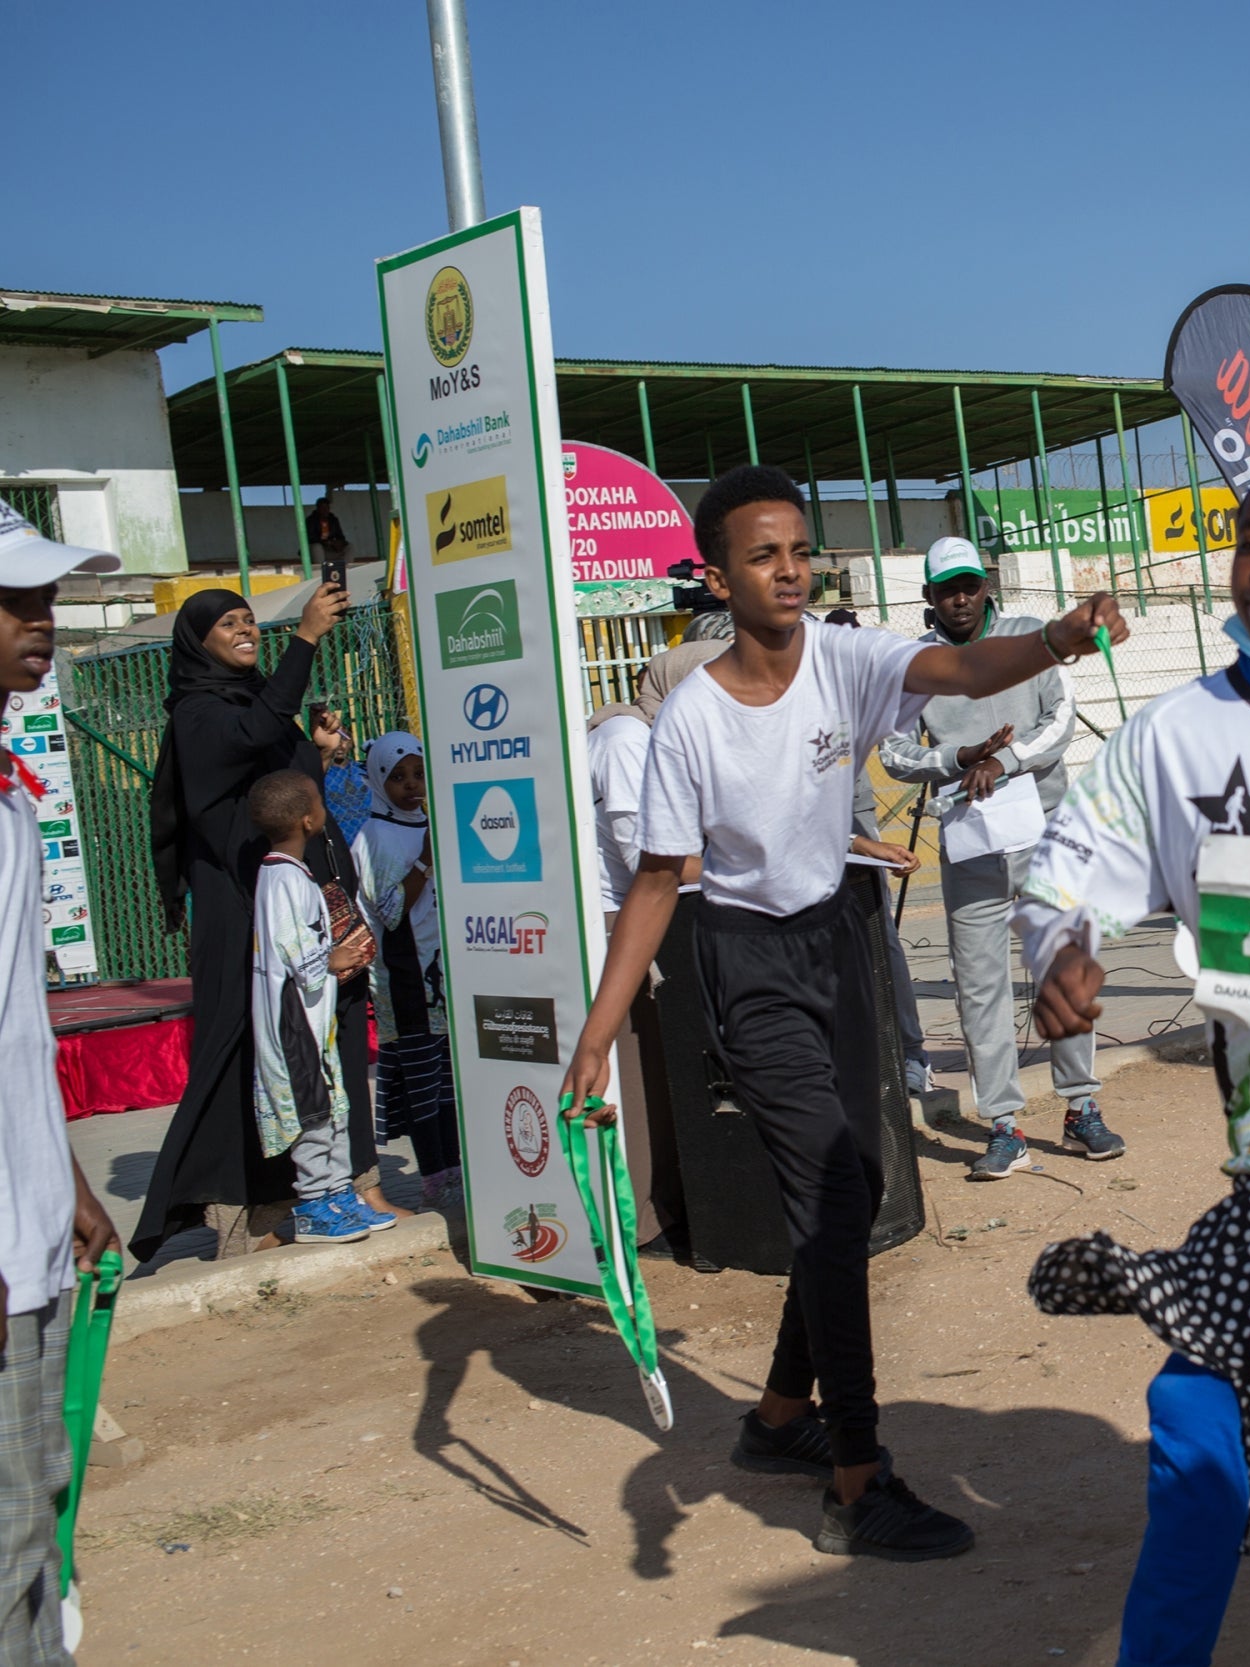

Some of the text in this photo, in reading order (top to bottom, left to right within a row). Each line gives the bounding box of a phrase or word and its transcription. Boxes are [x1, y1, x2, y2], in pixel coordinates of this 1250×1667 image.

[429, 364, 481, 401] MoY&S
[484, 410, 510, 432] Bank
[459, 506, 505, 542] somtel
[977, 503, 1141, 548] Dahabshiil
[573, 558, 654, 579] STADIUM
[447, 627, 505, 654] Dahabshiil
[451, 737, 531, 764] HYUNDAI
[480, 811, 516, 831] dasani
